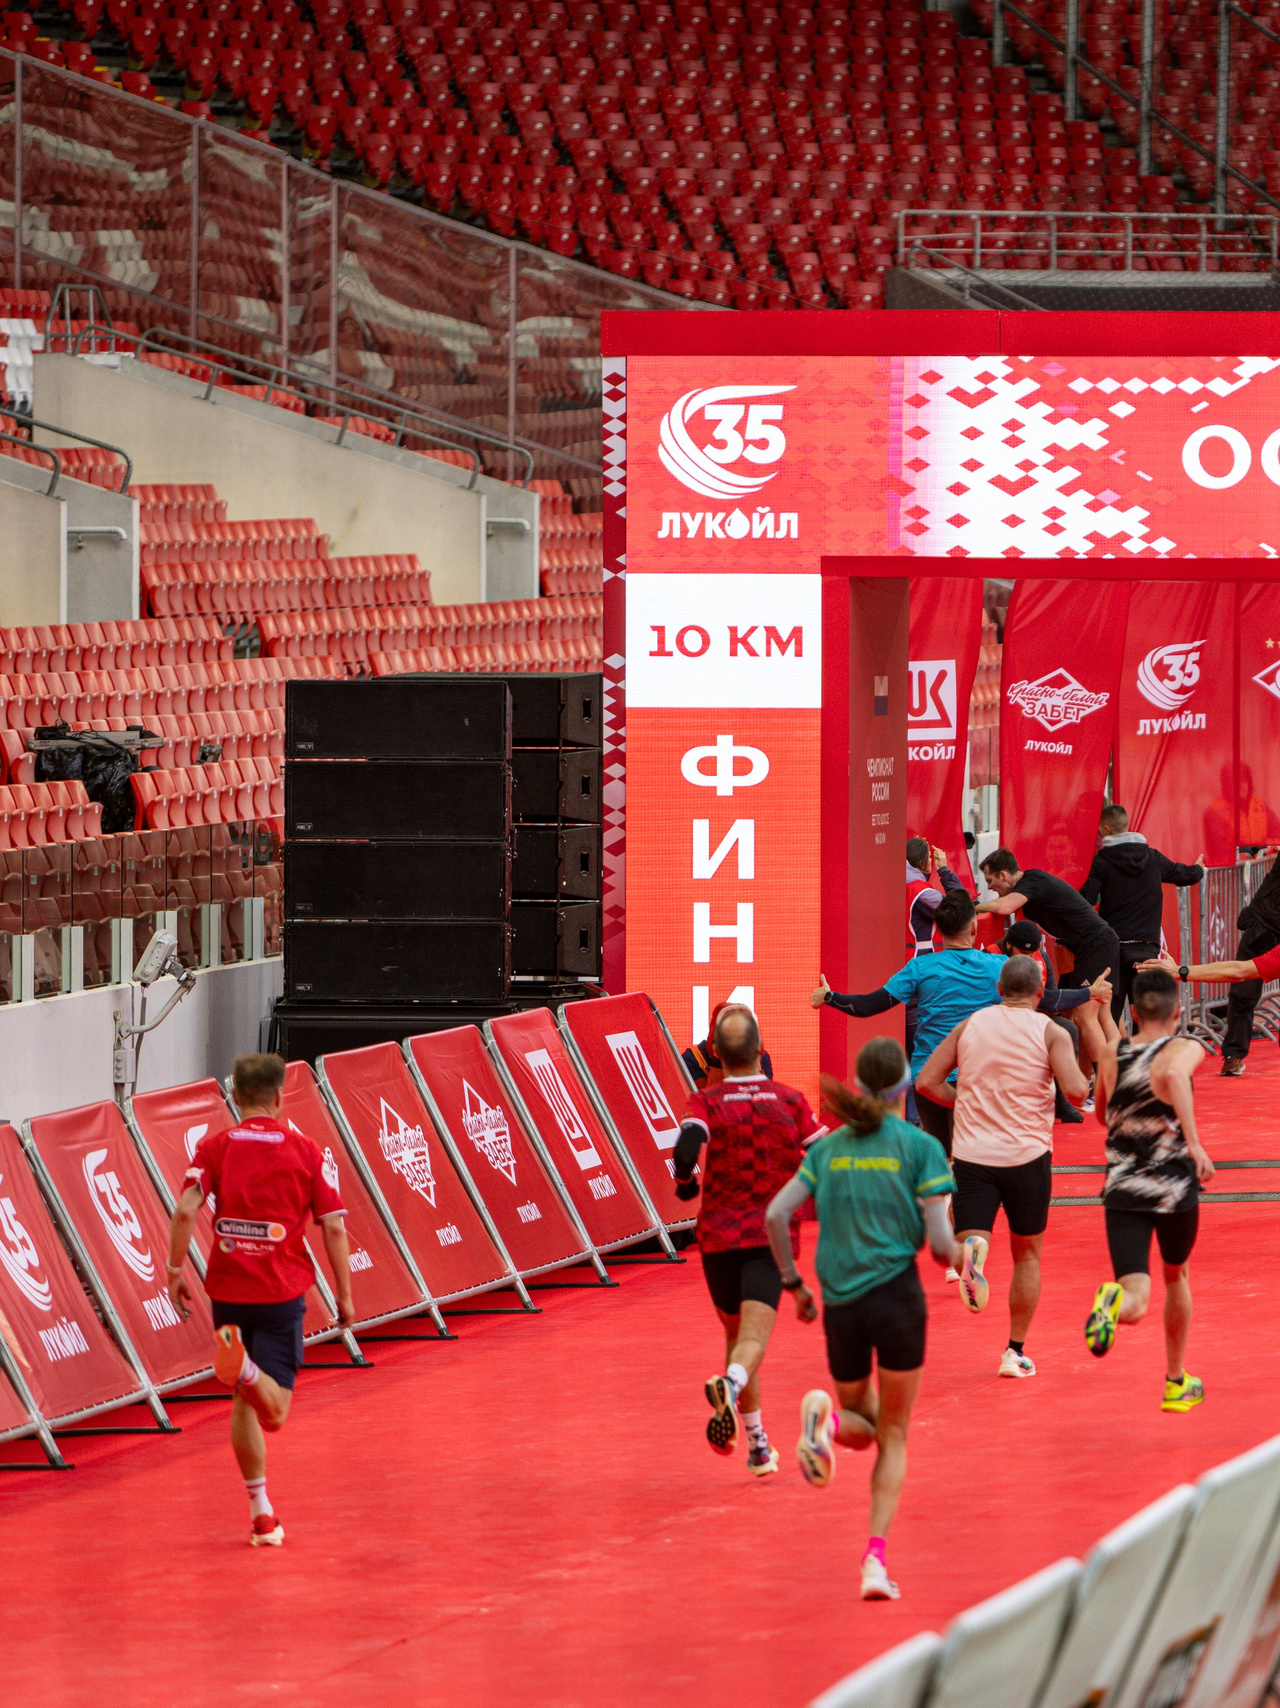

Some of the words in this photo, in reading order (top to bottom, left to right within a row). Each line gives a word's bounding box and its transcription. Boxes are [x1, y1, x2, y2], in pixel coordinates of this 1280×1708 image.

[702, 404, 786, 465] 35
[657, 506, 799, 539] ЛУКОЙЛ
[649, 625, 711, 658] 10
[1162, 651, 1201, 690] 35
[1024, 701, 1086, 722] ЗАБЕГ
[1137, 710, 1206, 735] ЛУКОЙЛ
[908, 745, 956, 761] КОЙЛ
[1024, 740, 1073, 755] ЛУКОЙЛ
[38, 1316, 90, 1363] ЛУКОЙЛ
